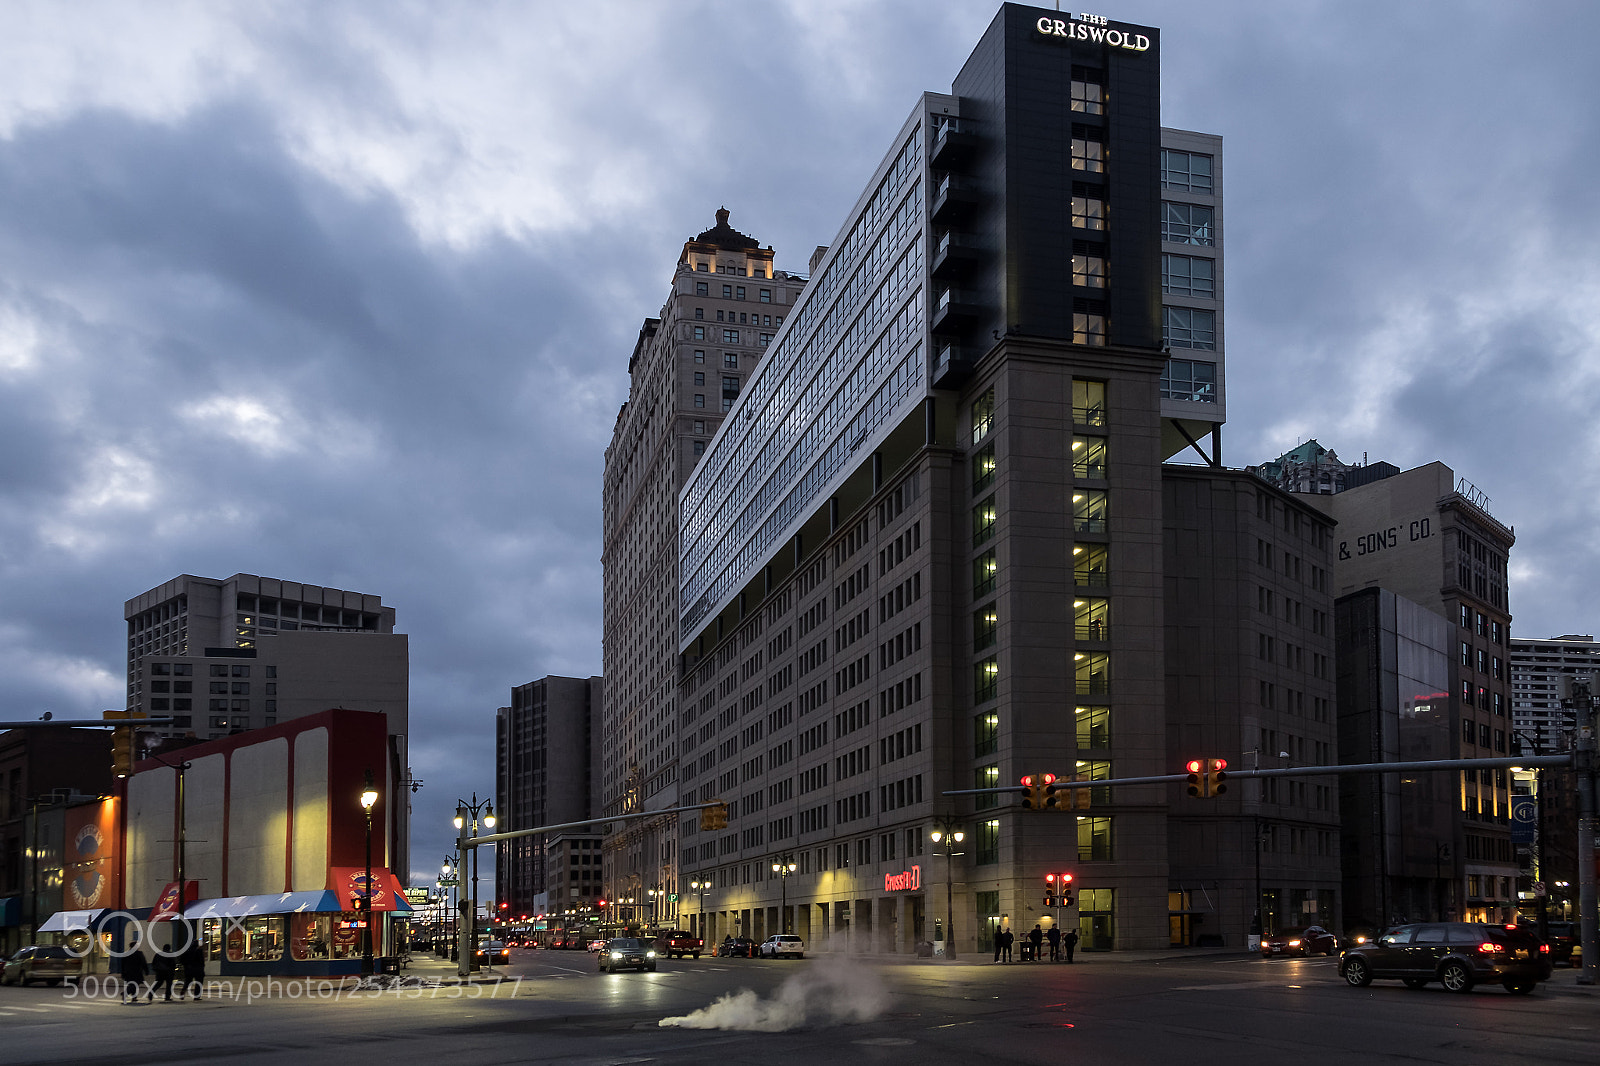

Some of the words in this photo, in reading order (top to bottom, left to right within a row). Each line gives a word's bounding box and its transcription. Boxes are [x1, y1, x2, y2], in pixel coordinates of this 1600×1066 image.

[1037, 17, 1150, 51] GRISWOLD
[1081, 13, 1107, 25] THE
[1339, 541, 1351, 560] &
[1410, 517, 1435, 541] CO.
